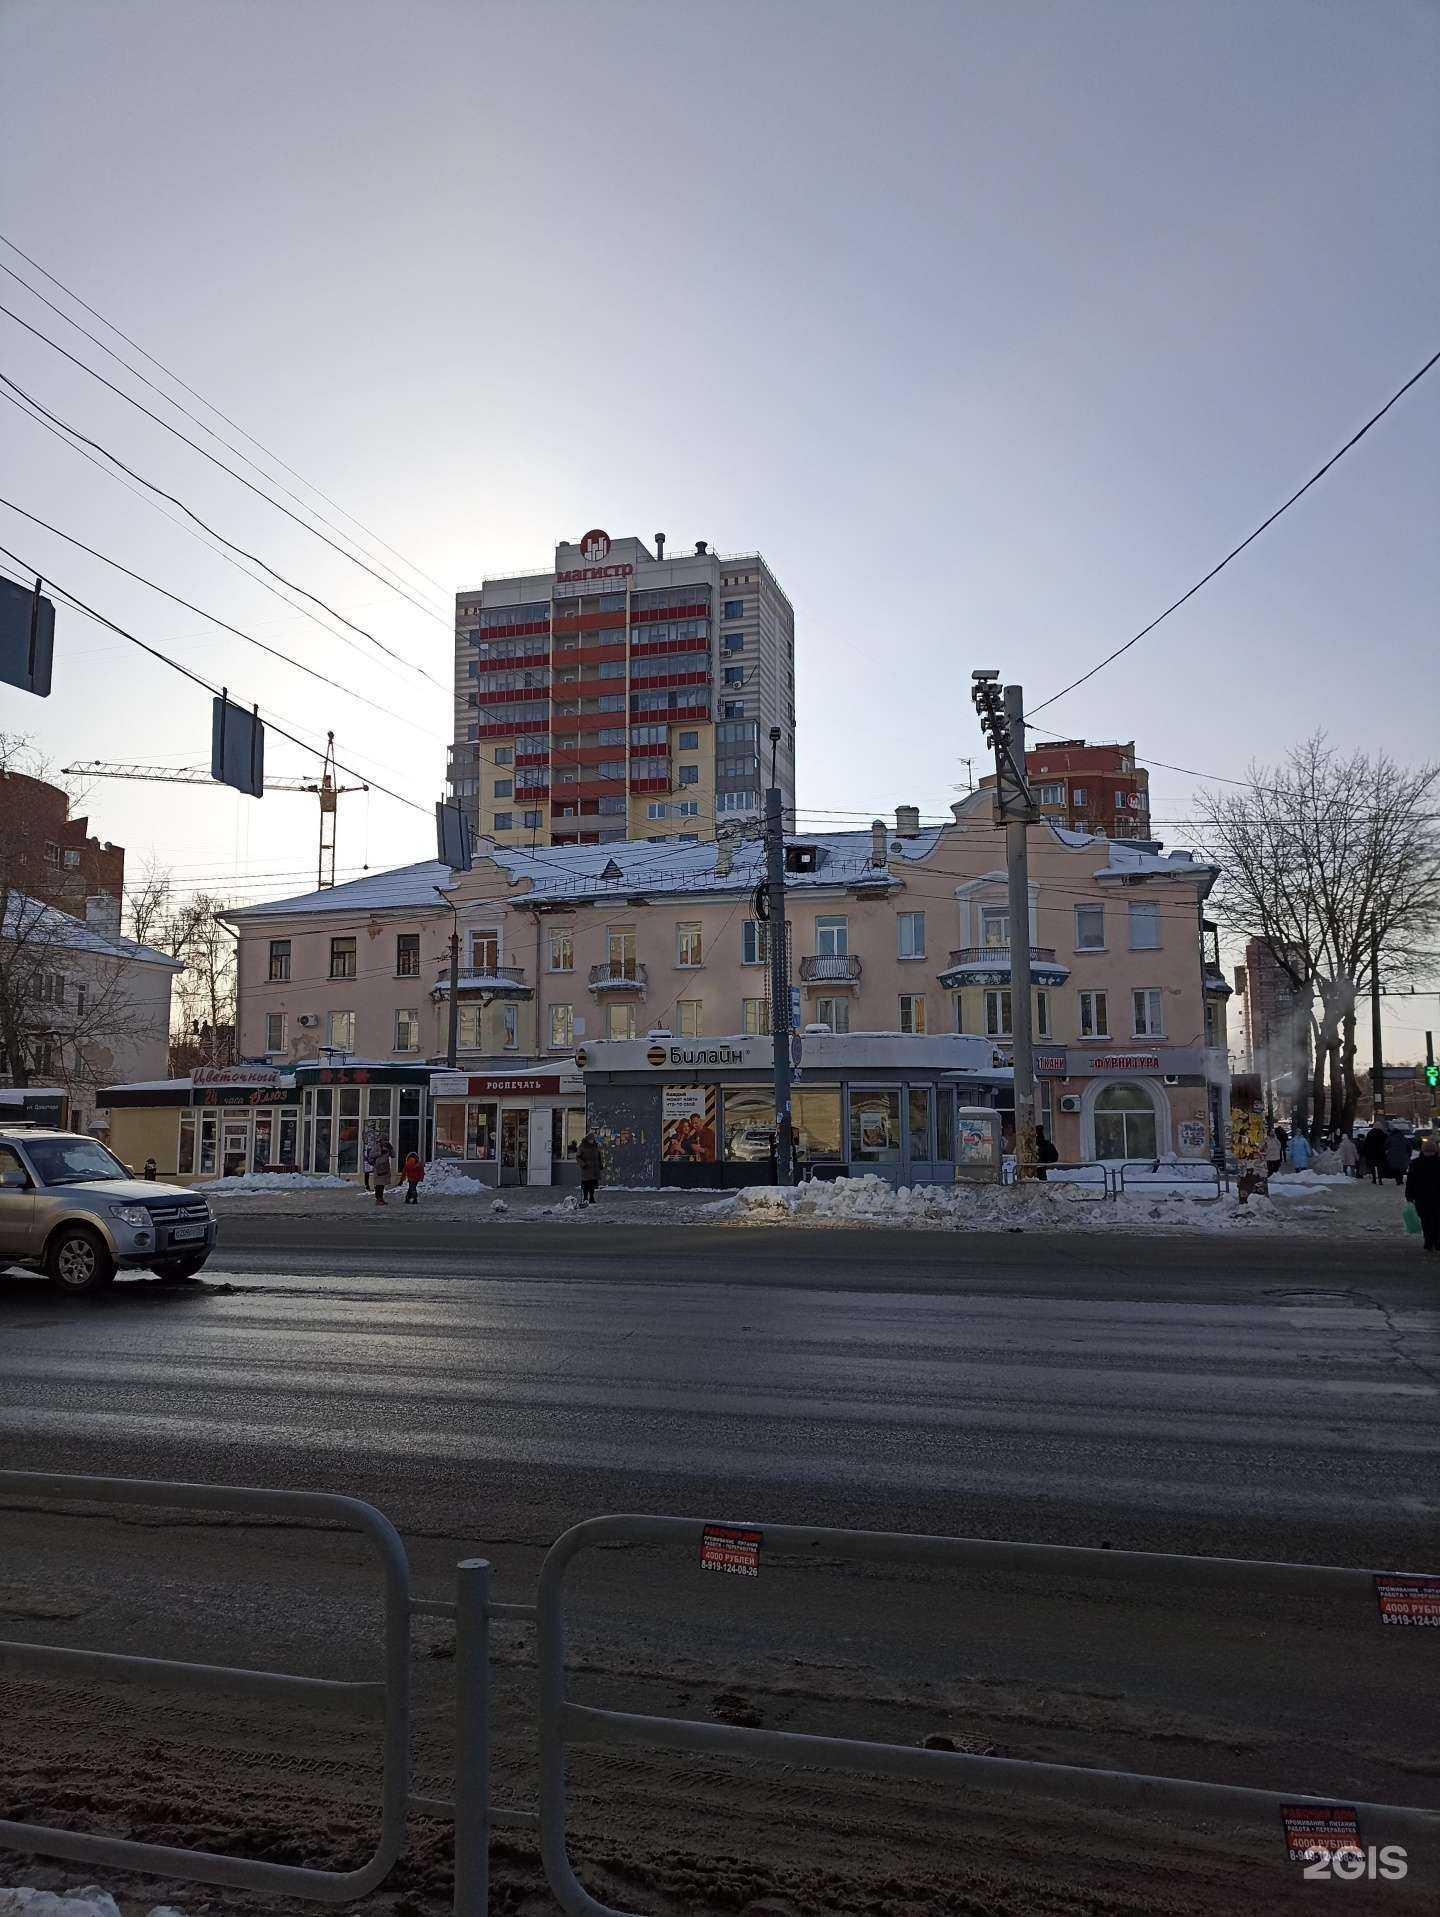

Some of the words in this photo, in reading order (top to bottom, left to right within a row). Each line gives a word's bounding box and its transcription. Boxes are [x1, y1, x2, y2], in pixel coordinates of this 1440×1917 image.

[1095, 1056, 1159, 1069] ФУРНИТУРА
[194, 1069, 278, 1084] Цветочный
[487, 1081, 542, 1090] РОСПЕЧАТЬ
[706, 1552, 723, 1561] 4000
[1385, 1603, 1409, 1613] 4000
[1411, 1604, 1440, 1614] РУБЛ
[1382, 1614, 1440, 1626] 8-919-124-0
[1292, 1838, 1316, 1848] 4000
